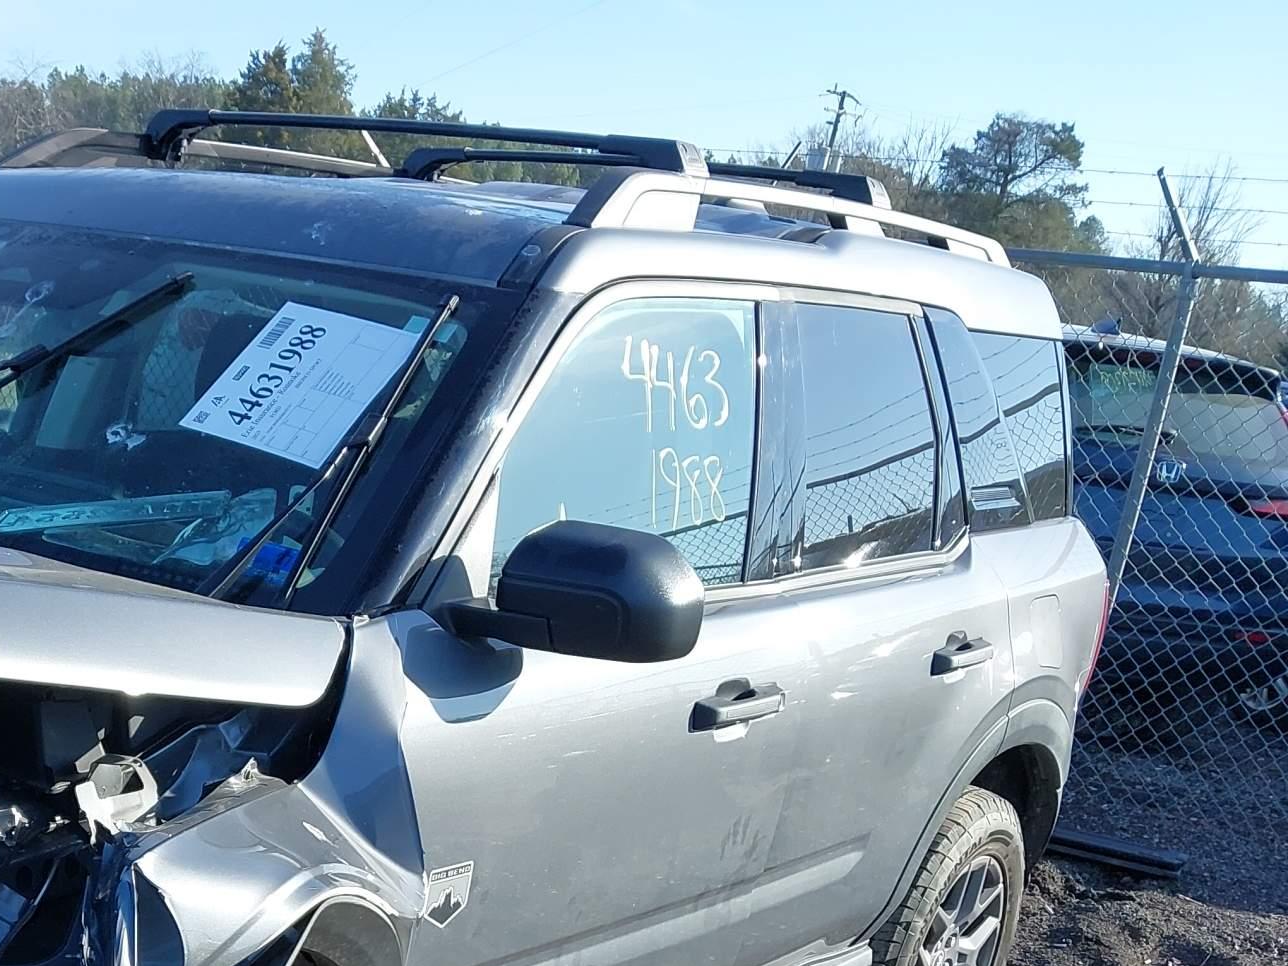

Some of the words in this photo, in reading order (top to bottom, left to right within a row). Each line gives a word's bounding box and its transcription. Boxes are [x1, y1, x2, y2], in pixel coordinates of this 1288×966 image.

[227, 323, 328, 427] 44631988
[621, 335, 730, 433] 4463
[652, 447, 727, 532] 1988
[431, 872, 447, 882] BIG
[447, 865, 471, 877] BEND
